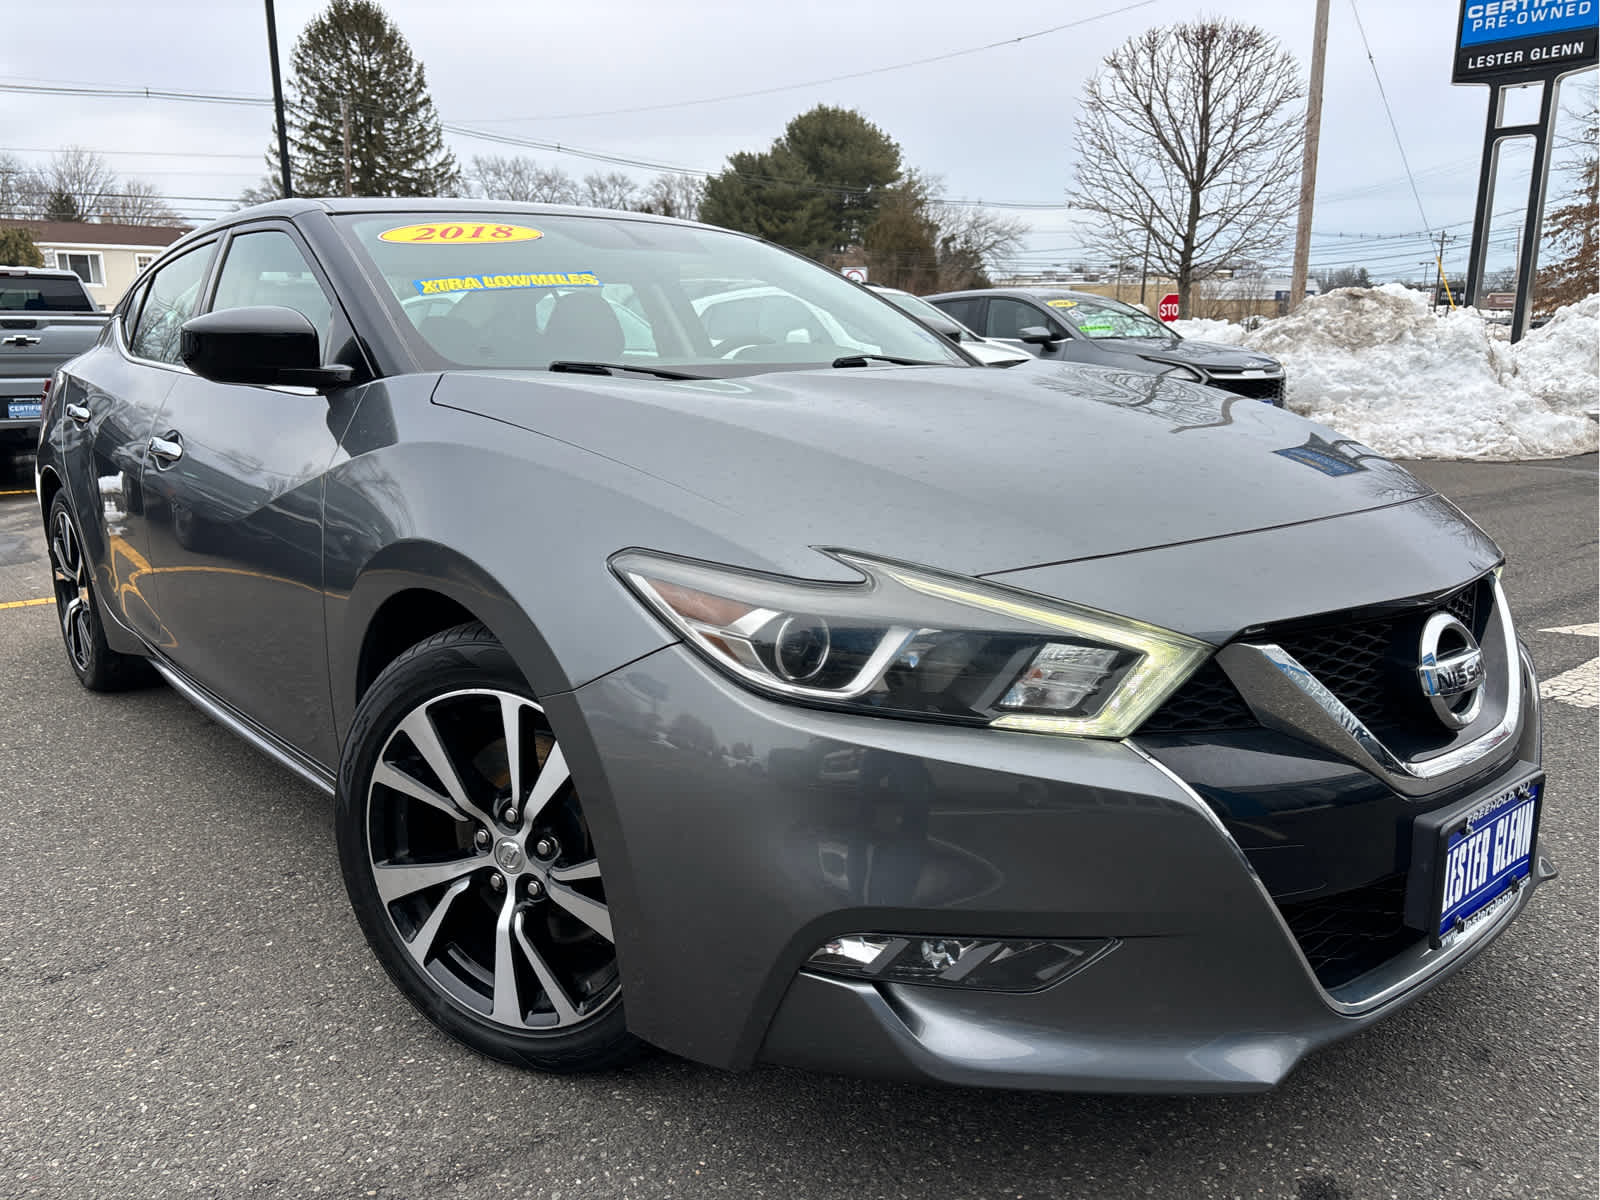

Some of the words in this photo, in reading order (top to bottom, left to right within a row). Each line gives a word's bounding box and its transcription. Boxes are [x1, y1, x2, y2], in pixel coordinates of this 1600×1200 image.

[1467, 0, 1577, 19] CERTI
[1472, 1, 1591, 32] PRE-OWNED
[1468, 51, 1523, 69] LESTER
[1530, 42, 1584, 60] GLENN
[412, 226, 514, 241] 2018
[420, 277, 482, 294] XTRA
[1160, 303, 1179, 316] STO
[9, 404, 43, 412] CERTIFI
[1437, 662, 1485, 689] NISSA
[1442, 827, 1491, 913] LESTER
[1492, 799, 1535, 877] GLENN
